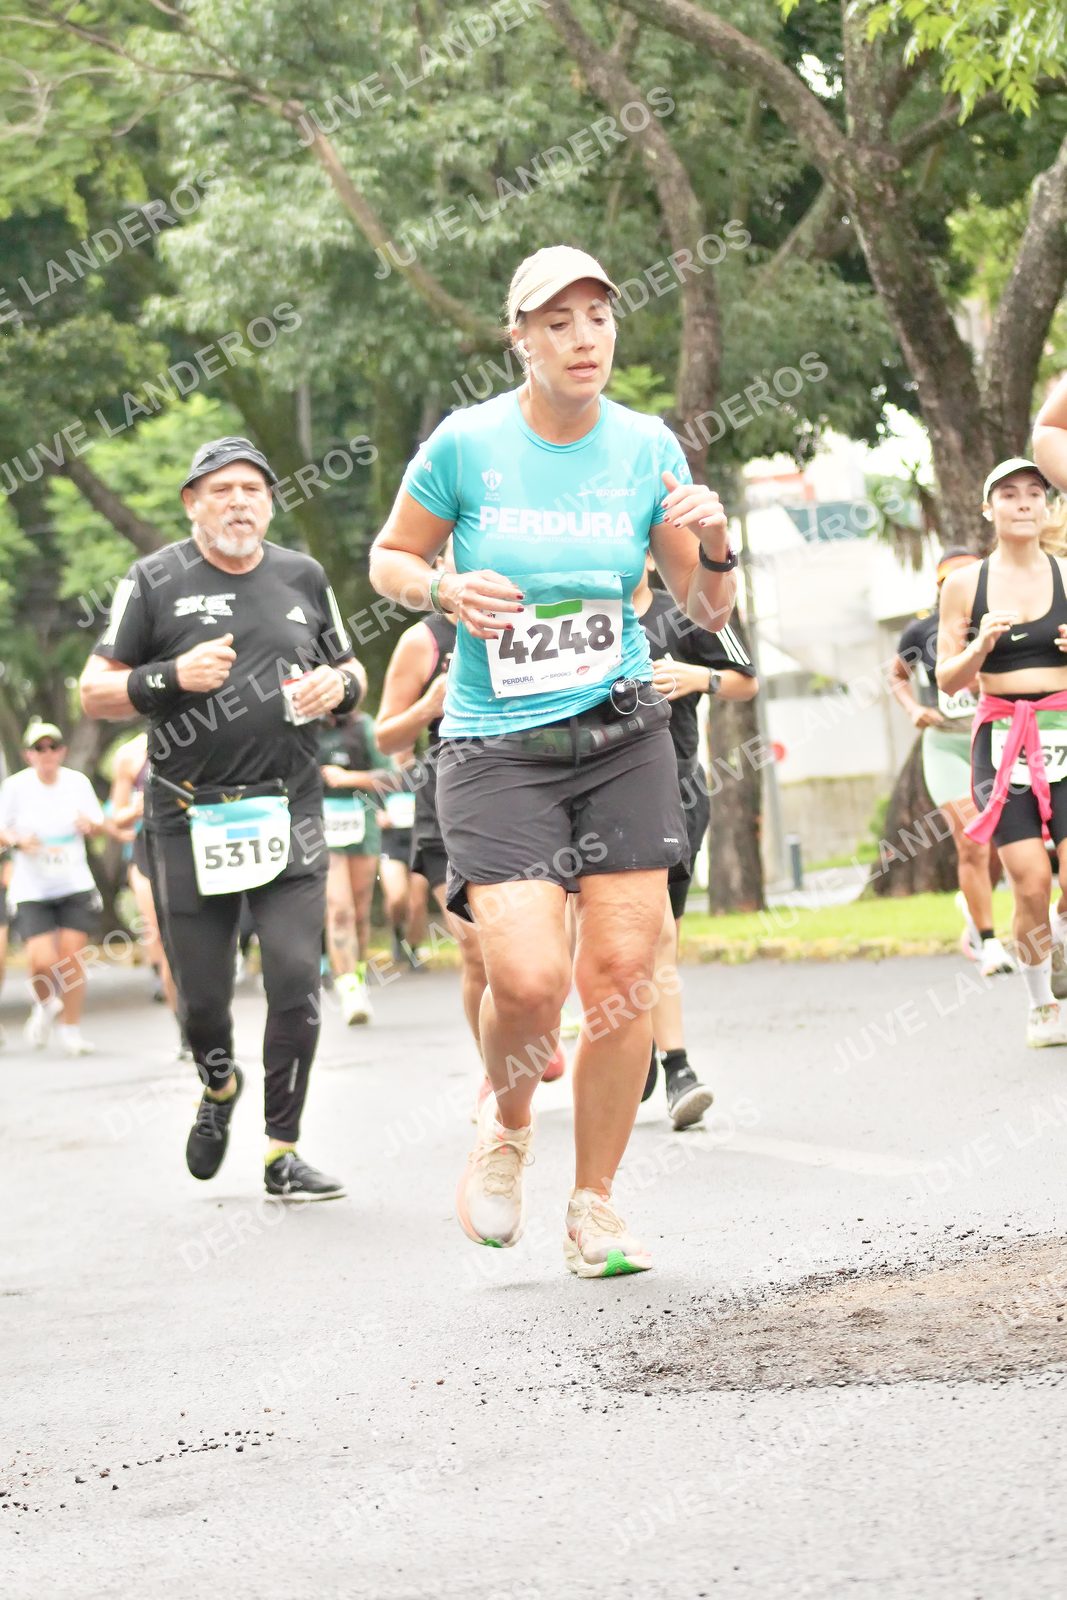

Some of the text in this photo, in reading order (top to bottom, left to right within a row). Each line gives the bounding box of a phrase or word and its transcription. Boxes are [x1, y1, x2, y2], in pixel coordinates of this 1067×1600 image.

[596, 488, 638, 497] BROOKS
[479, 505, 635, 537] PERDURA
[498, 614, 615, 665] 4248
[502, 675, 534, 686] PERDURA
[205, 836, 285, 870] 5319
